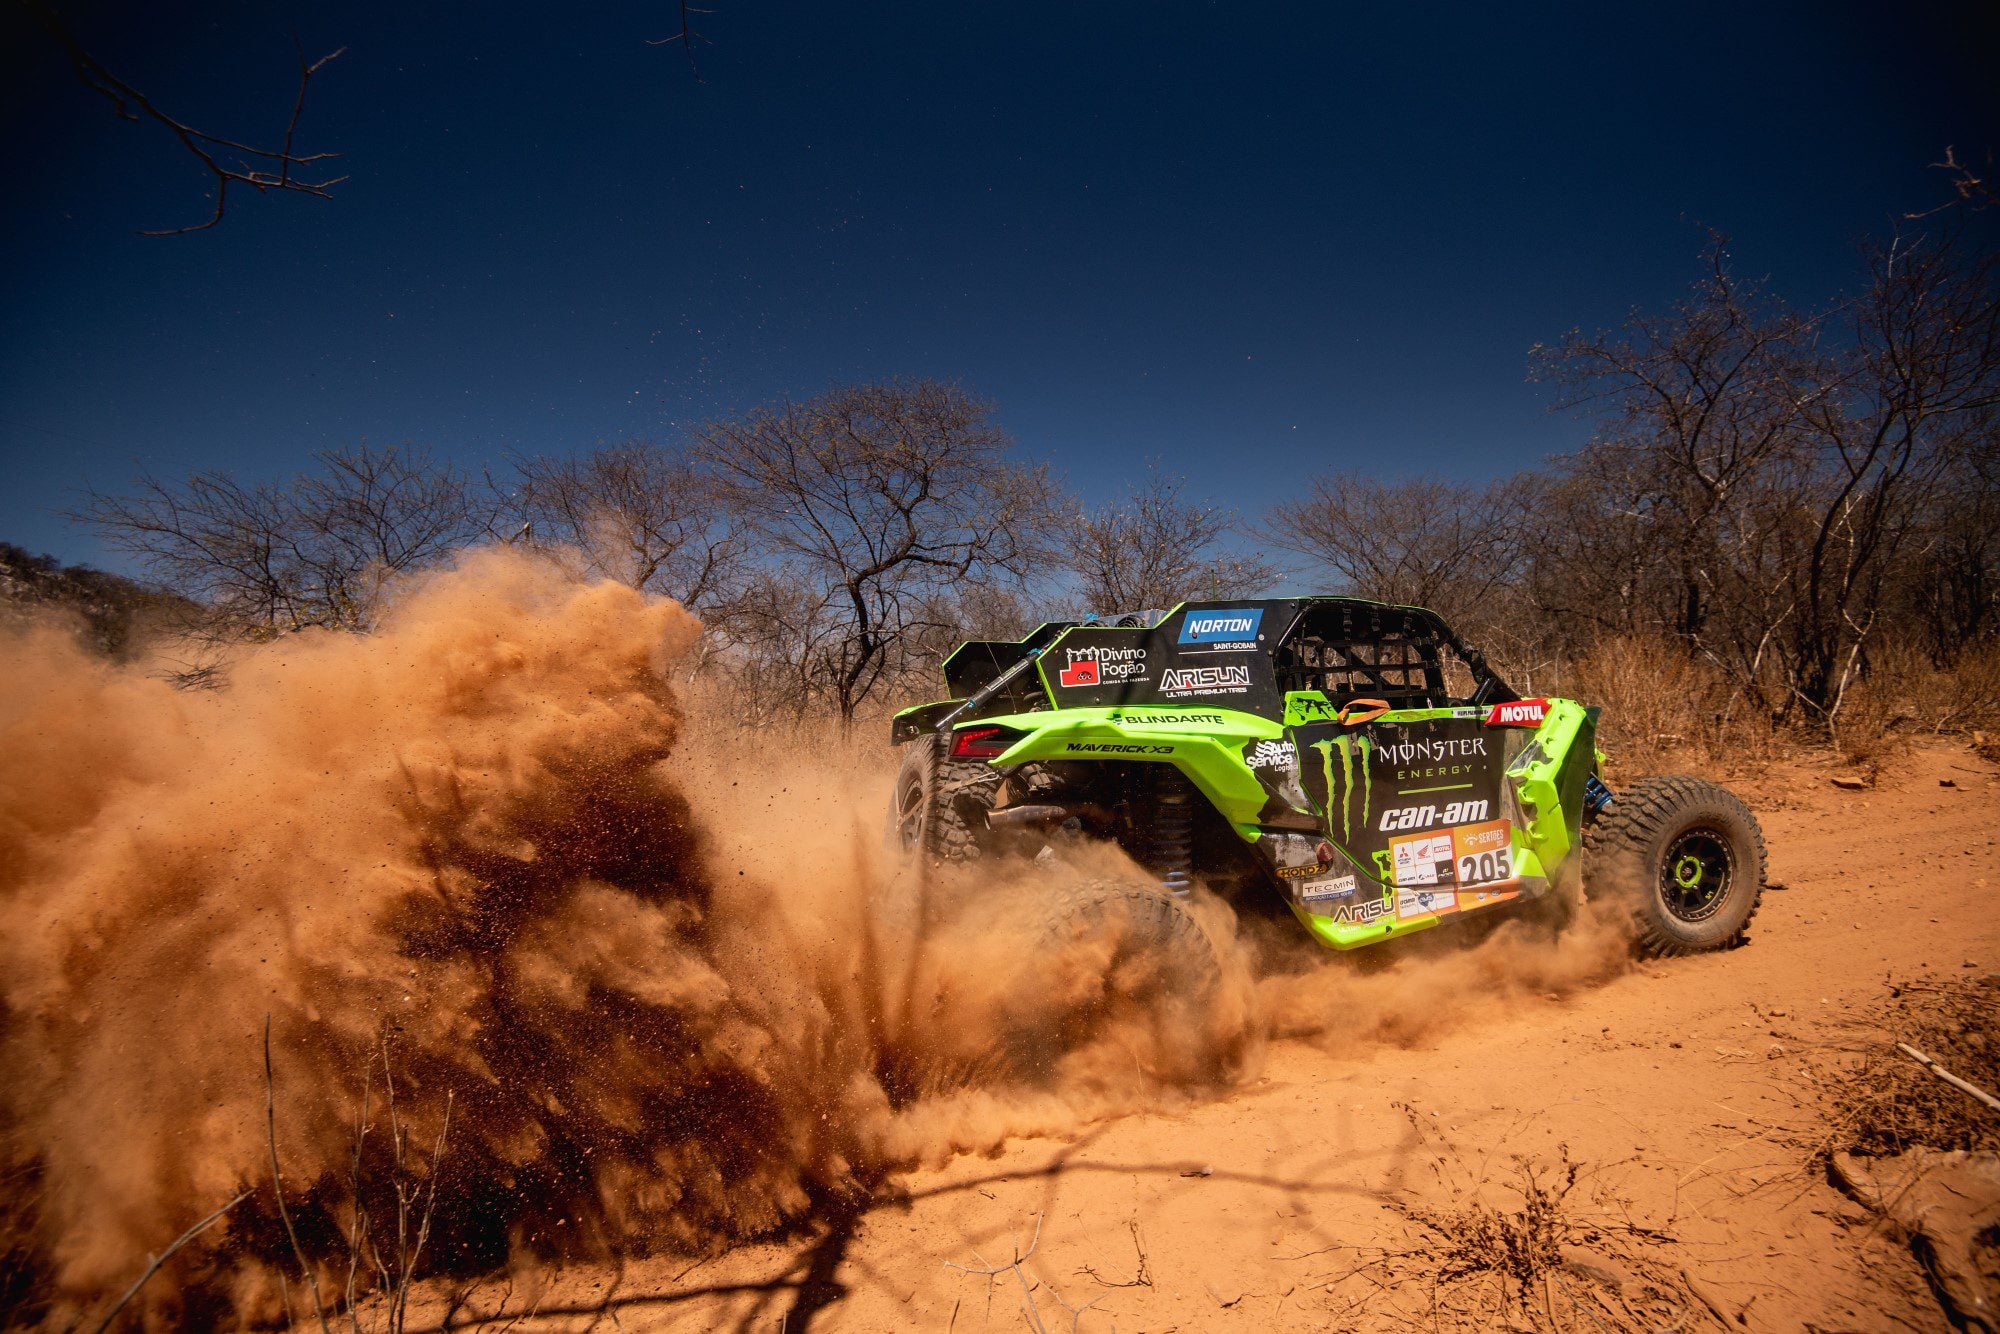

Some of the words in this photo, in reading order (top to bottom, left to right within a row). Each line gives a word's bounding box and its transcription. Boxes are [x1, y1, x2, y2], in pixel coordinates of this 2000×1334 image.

[1188, 618, 1253, 634] NORTON
[1100, 646, 1146, 661] Divino
[1213, 642, 1257, 650] SAINT-GOBAIN
[1101, 660, 1146, 678] Fogão
[1159, 666, 1250, 689] ARISUN
[1166, 690, 1192, 698] ULTRA
[1194, 688, 1227, 696] PREMIUM
[1228, 686, 1248, 694] TIRES
[1125, 714, 1225, 725] BLINDARTE
[1500, 705, 1545, 722] MOTUL
[1066, 743, 1149, 754] MAVERICK
[1149, 745, 1175, 754] X3
[1270, 740, 1296, 755] Auto
[1246, 753, 1293, 770] Service
[1397, 764, 1474, 780] ENERGY
[1378, 799, 1489, 832] can-am
[1478, 829, 1505, 843] SERTÕES
[1461, 848, 1511, 887] 205
[1304, 879, 1354, 893] TECMIN
[1332, 896, 1396, 924] ARISU
